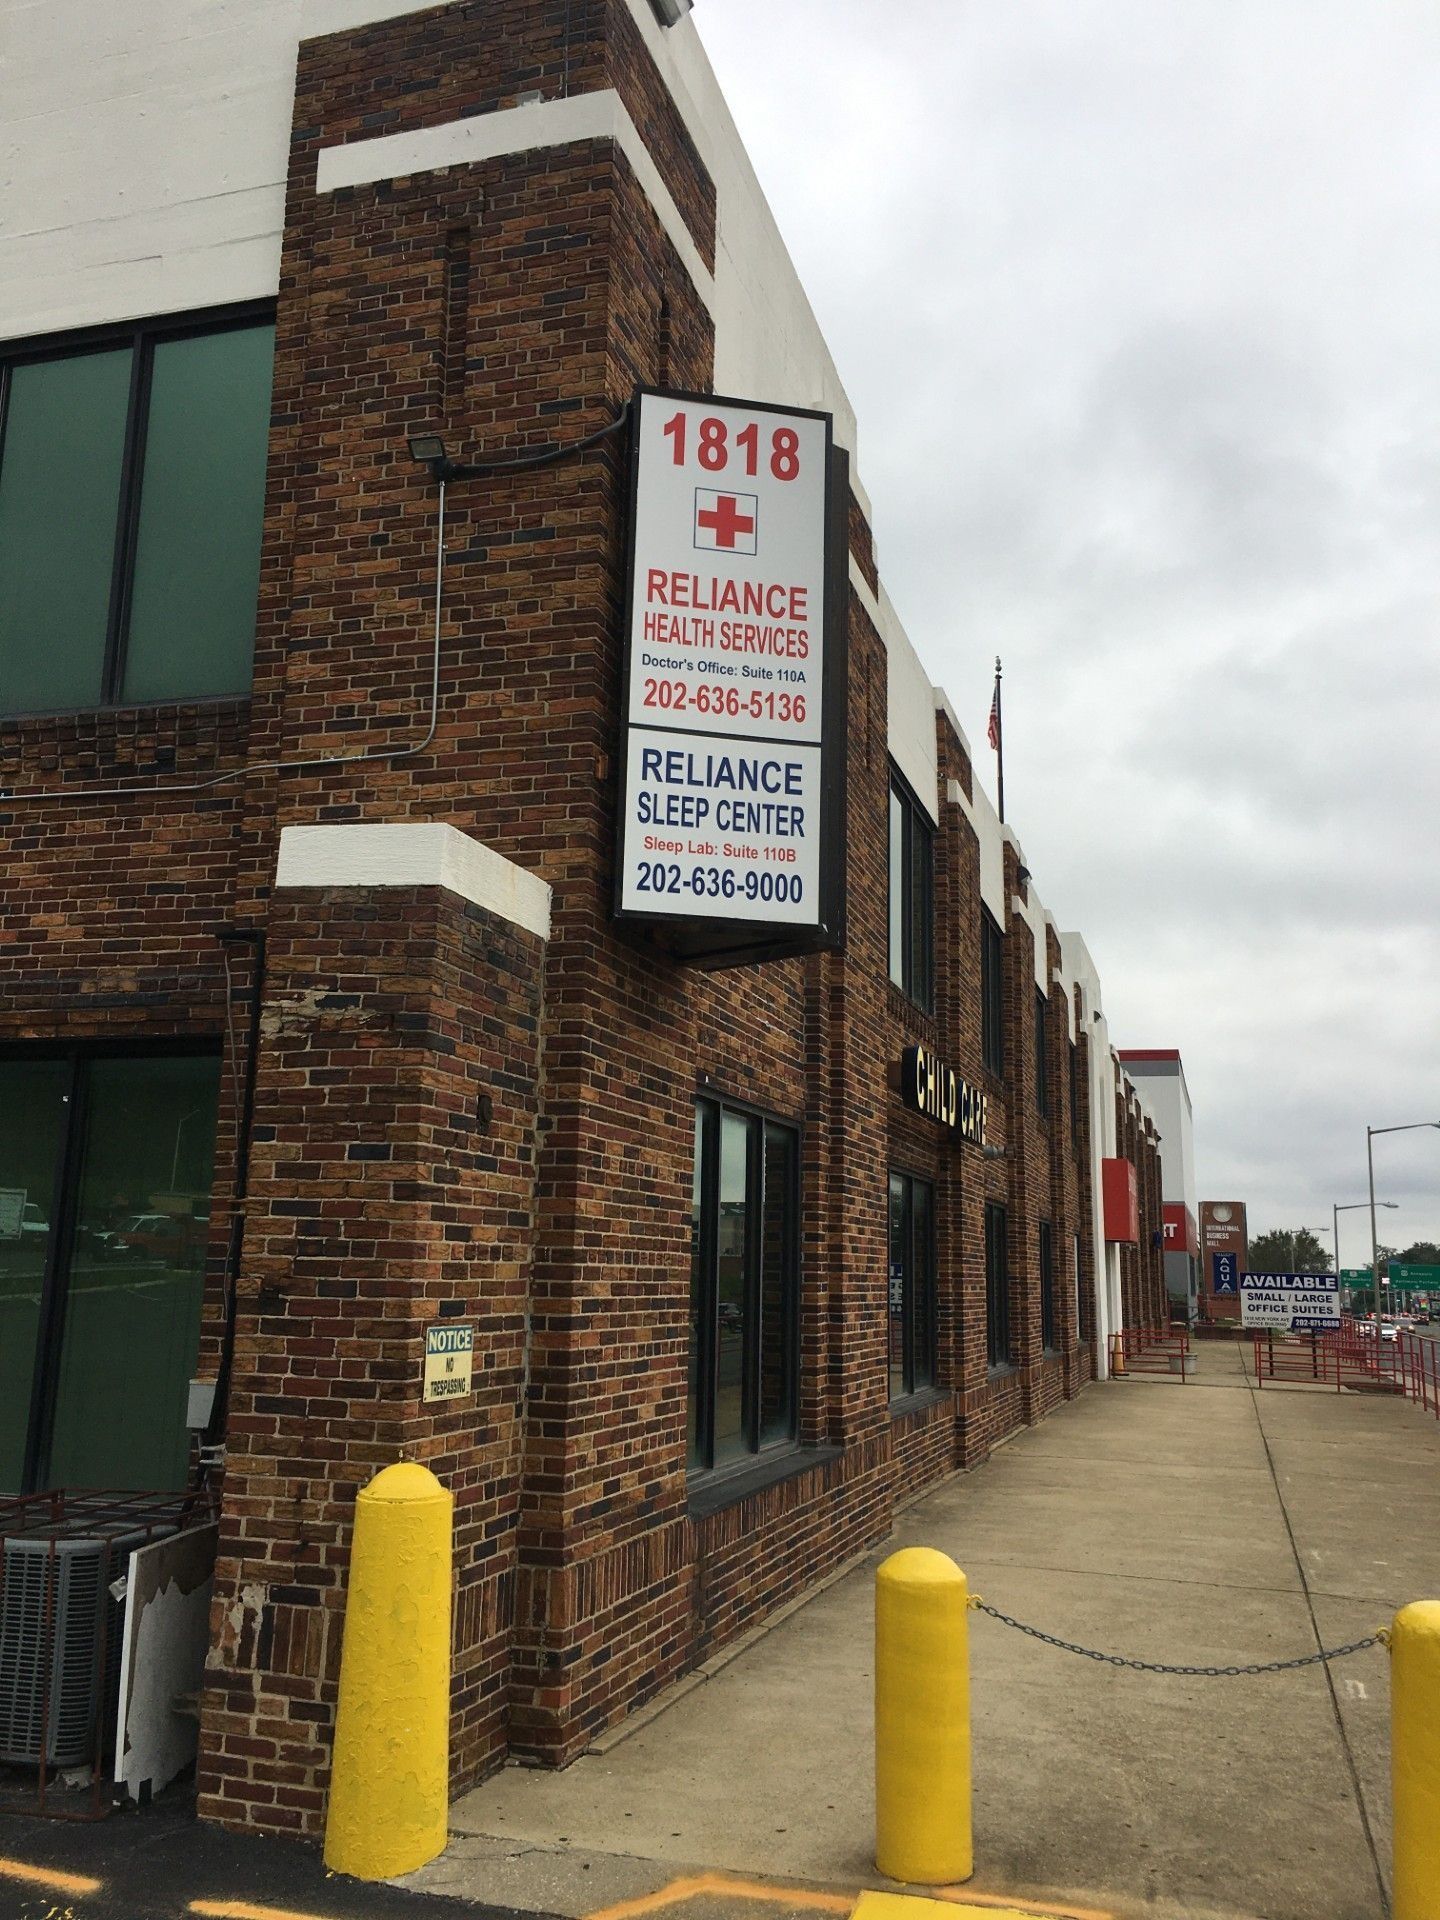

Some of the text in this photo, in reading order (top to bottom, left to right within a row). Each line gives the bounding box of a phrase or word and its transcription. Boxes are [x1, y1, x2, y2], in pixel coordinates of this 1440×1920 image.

[663, 412, 800, 482] 1818
[647, 568, 808, 622] RELIANCE
[644, 611, 809, 660] HEALTH SERVICES
[641, 653, 807, 684] Doctor's Office: Suite 110A
[643, 678, 806, 723] 202-636-5136
[641, 747, 803, 796] RELIANCE
[637, 791, 805, 838] SLEEP CENTER
[643, 835, 796, 863] Sleep Lab: Suite 110B
[636, 861, 803, 904] 202-636-9000
[916, 1045, 988, 1146] CHILD CARE
[1206, 1232, 1230, 1240] BUSINESS
[1219, 1257, 1231, 1290] AQUA
[1242, 1275, 1336, 1289] AVAILABLE
[1247, 1292, 1286, 1302] SMALL
[1294, 1294, 1333, 1304] LARGE
[1247, 1303, 1334, 1315] OFFICE SUITES
[428, 1330, 472, 1352] NOTICE
[445, 1357, 454, 1373] NO
[430, 1378, 466, 1397] TRESPASSING
